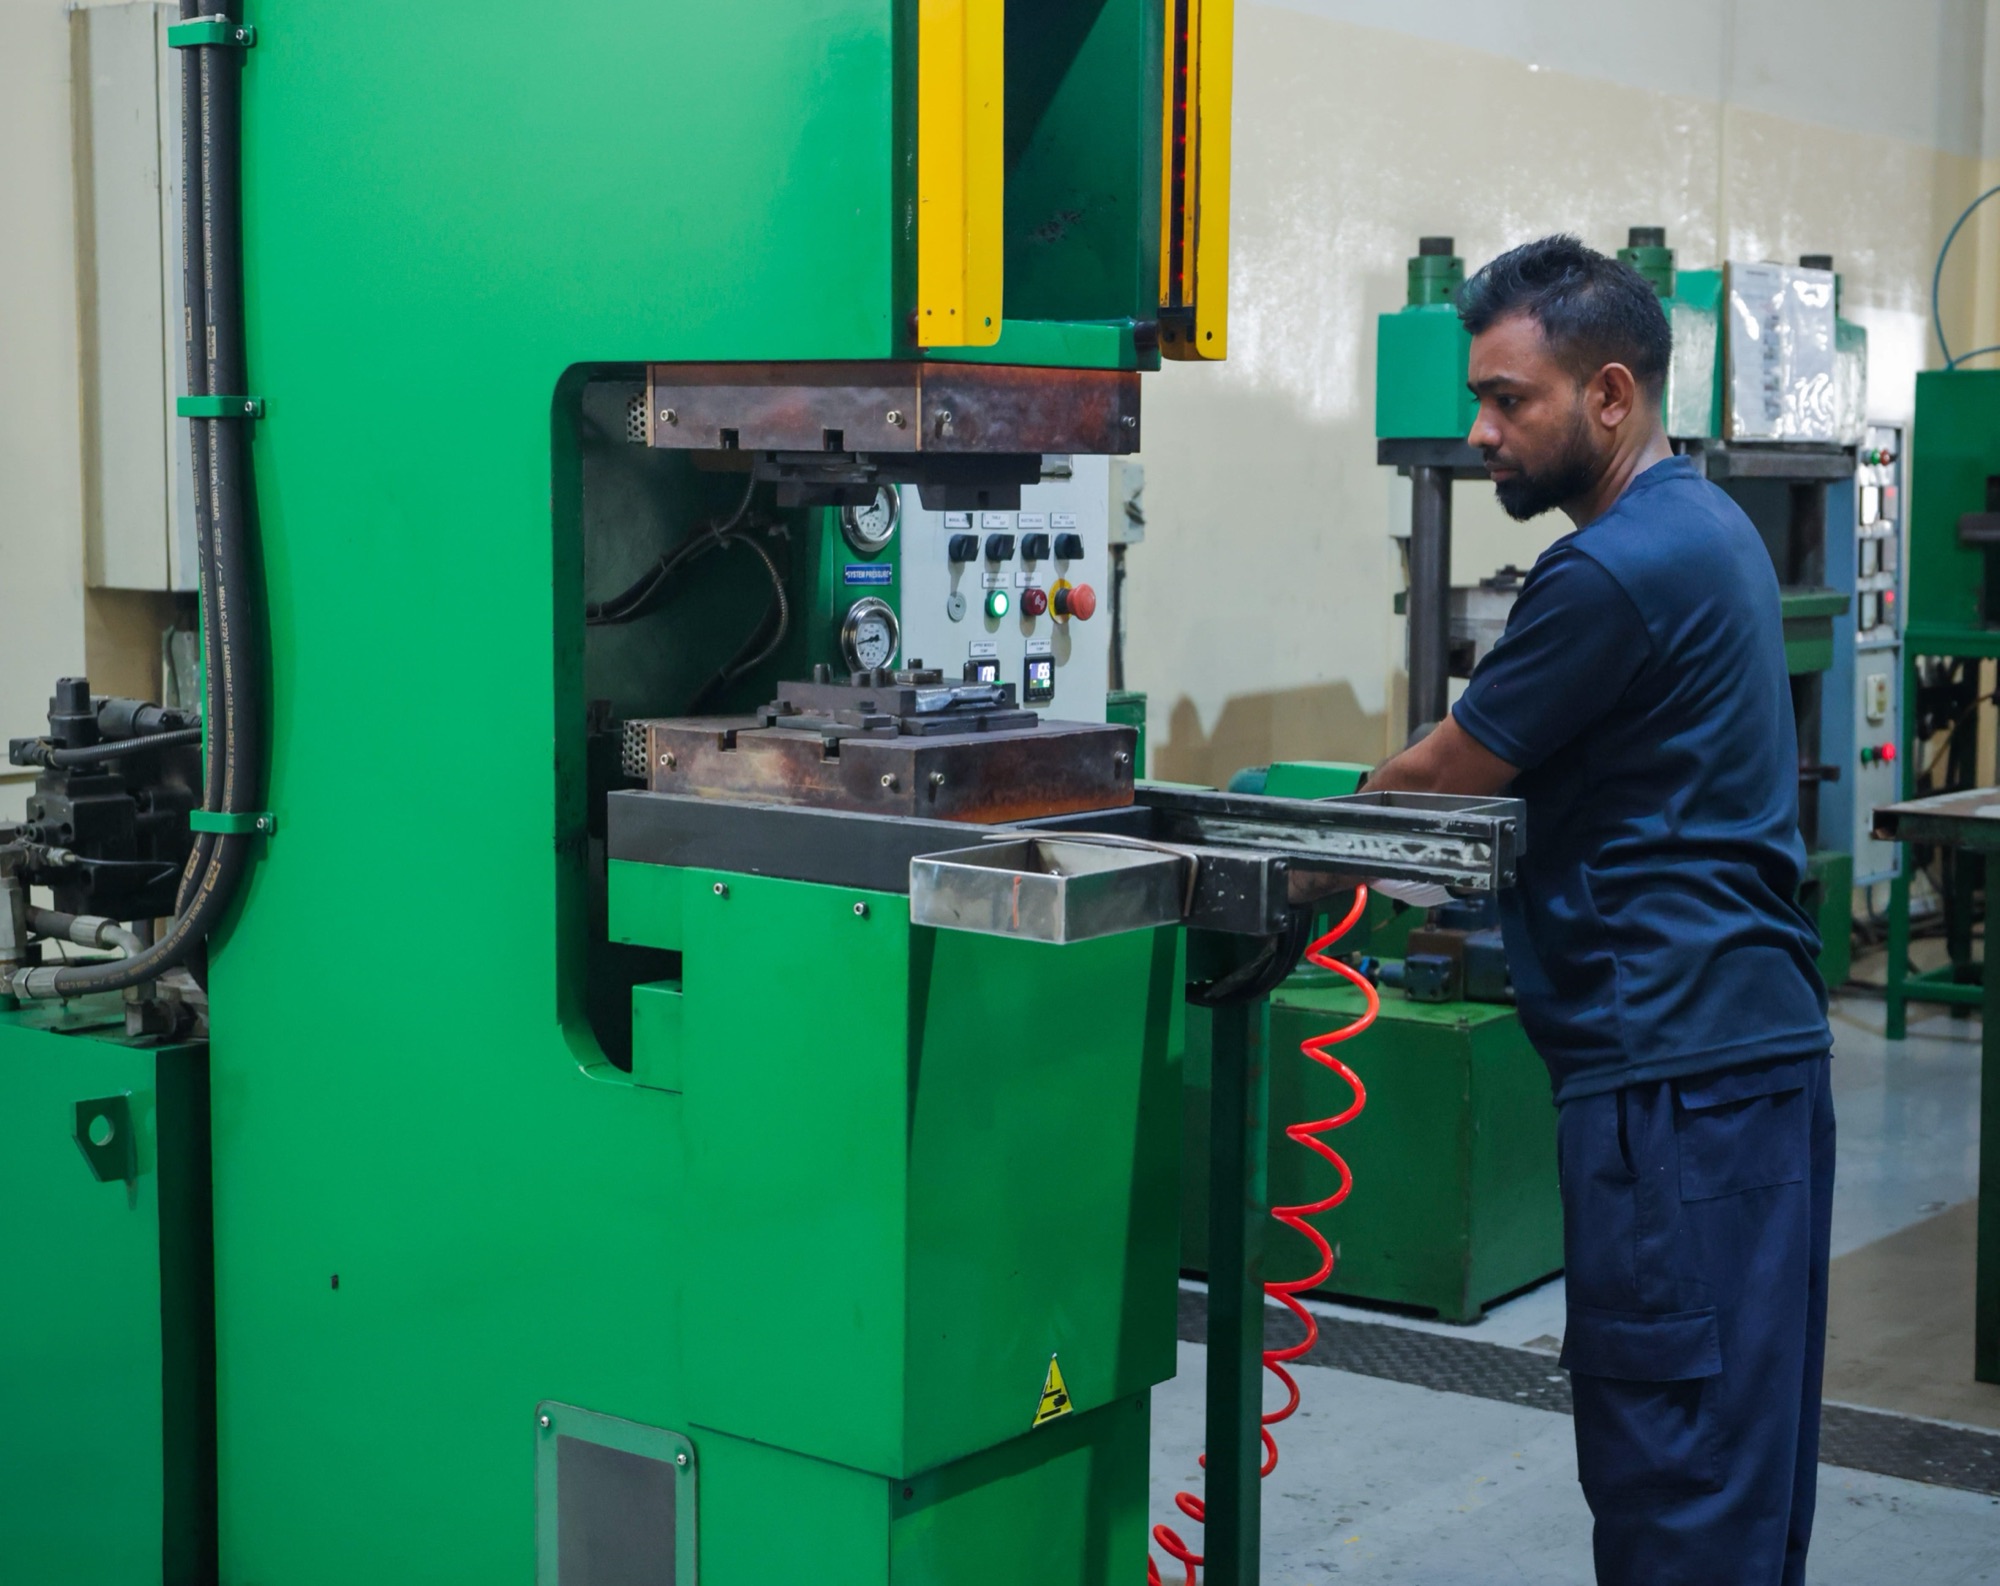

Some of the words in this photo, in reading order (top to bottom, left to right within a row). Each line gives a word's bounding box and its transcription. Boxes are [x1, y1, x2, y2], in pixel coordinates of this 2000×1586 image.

[207, 327, 216, 359] Parker
[847, 570, 865, 578] SYSTEM
[866, 570, 890, 578] PRESSURE
[218, 586, 227, 610] MSHA
[223, 644, 232, 692] SAE100R1AT
